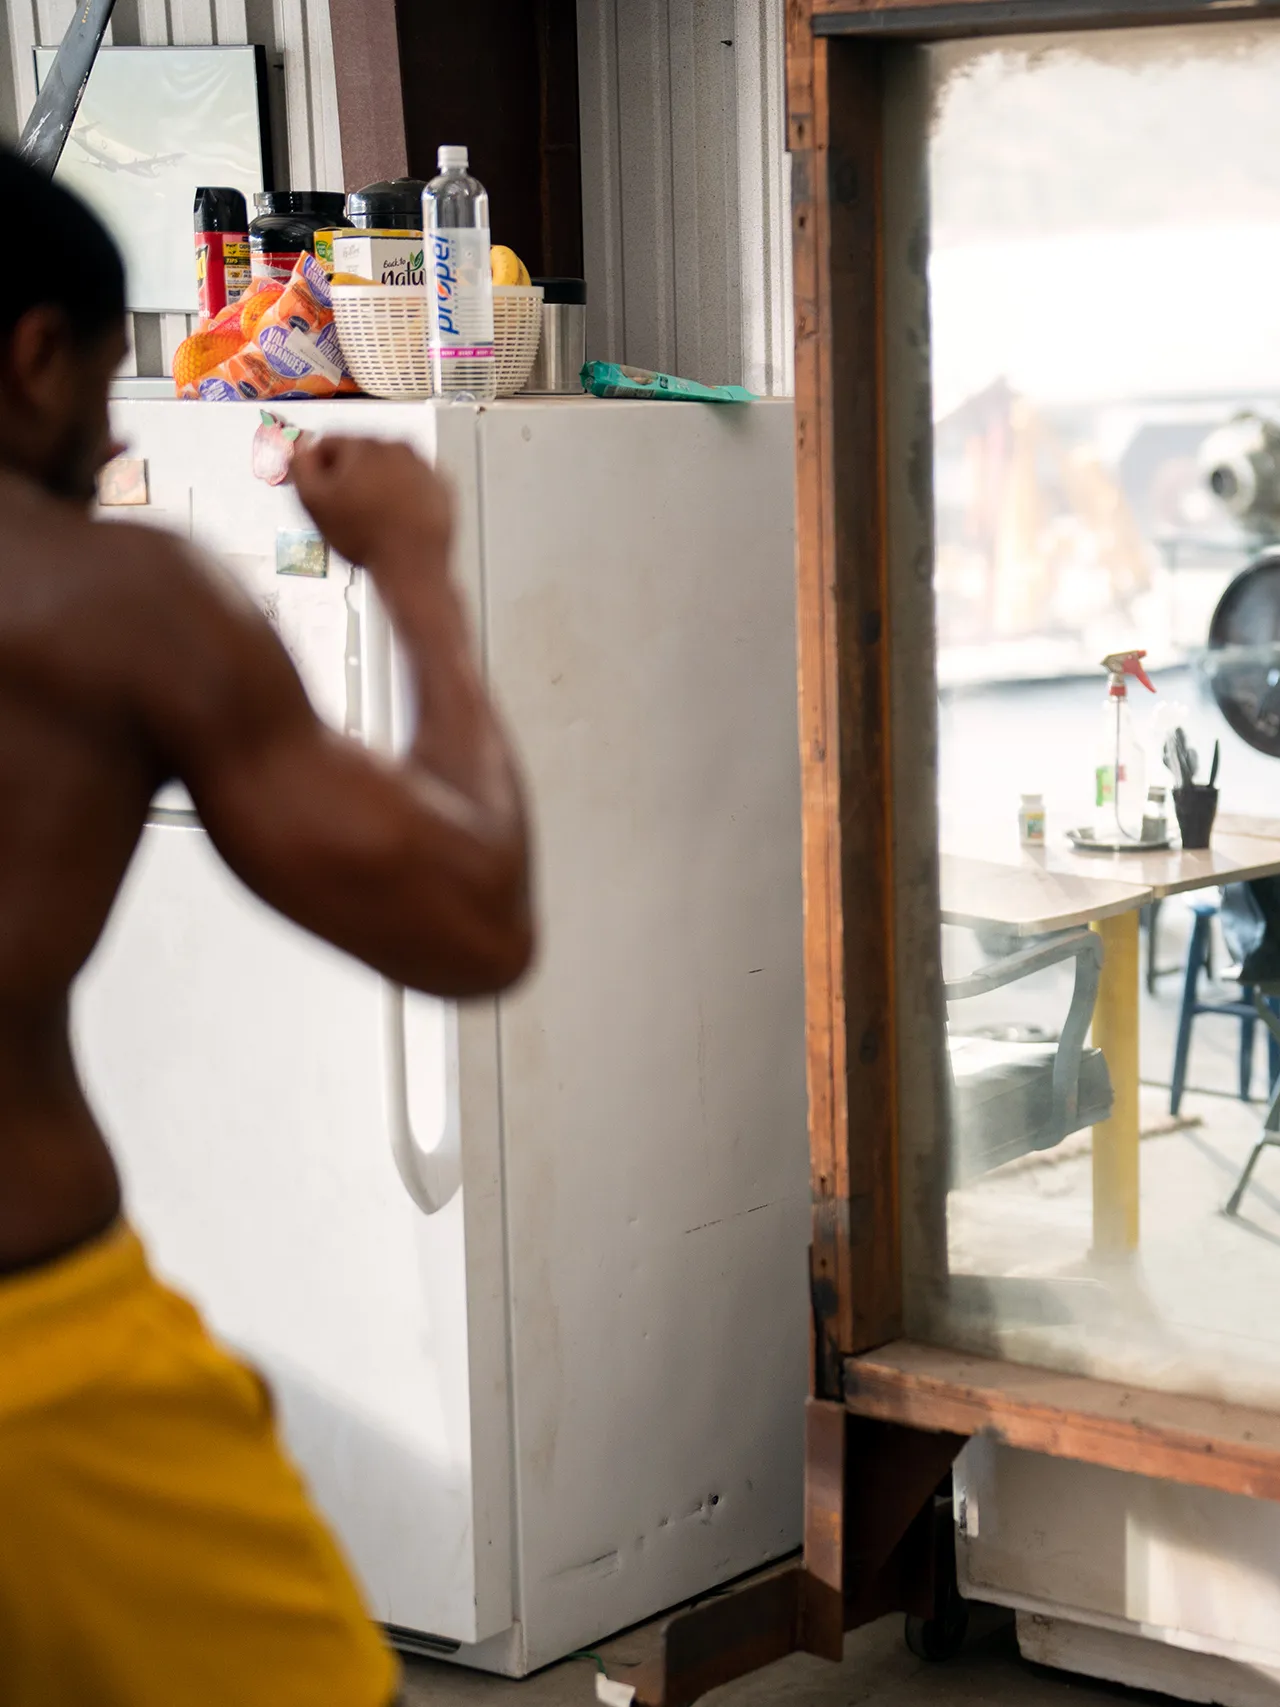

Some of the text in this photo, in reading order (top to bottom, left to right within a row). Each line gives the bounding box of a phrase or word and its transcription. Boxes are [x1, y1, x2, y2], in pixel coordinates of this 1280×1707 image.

[381, 261, 427, 286] natu
[383, 257, 407, 269] Back to
[432, 233, 459, 335] propel
[262, 340, 306, 375] ORANGES
